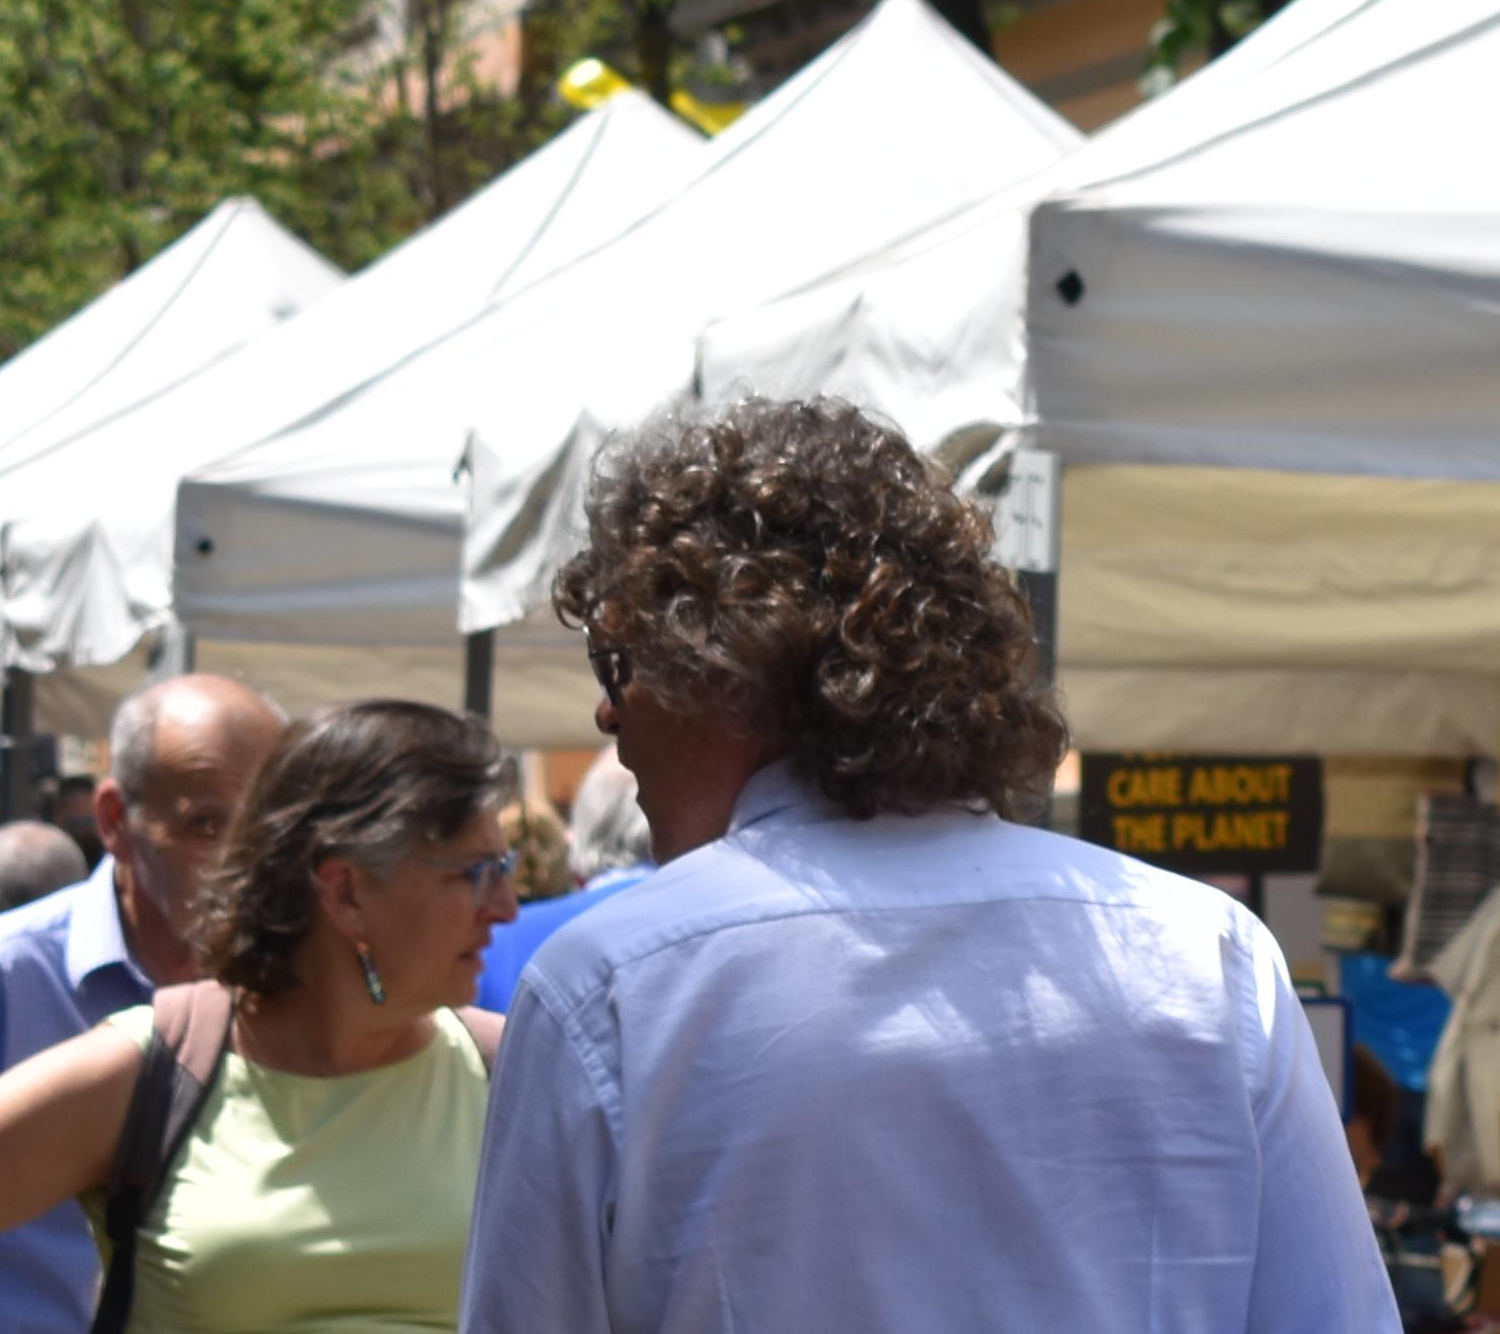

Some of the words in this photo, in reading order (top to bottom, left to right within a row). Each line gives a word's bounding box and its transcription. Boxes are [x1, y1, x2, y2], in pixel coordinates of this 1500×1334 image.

[1106, 768, 1182, 807] CARE
[1188, 763, 1291, 805] ABOUT
[1112, 813, 1167, 852] THE
[1171, 810, 1290, 851] PLANET
